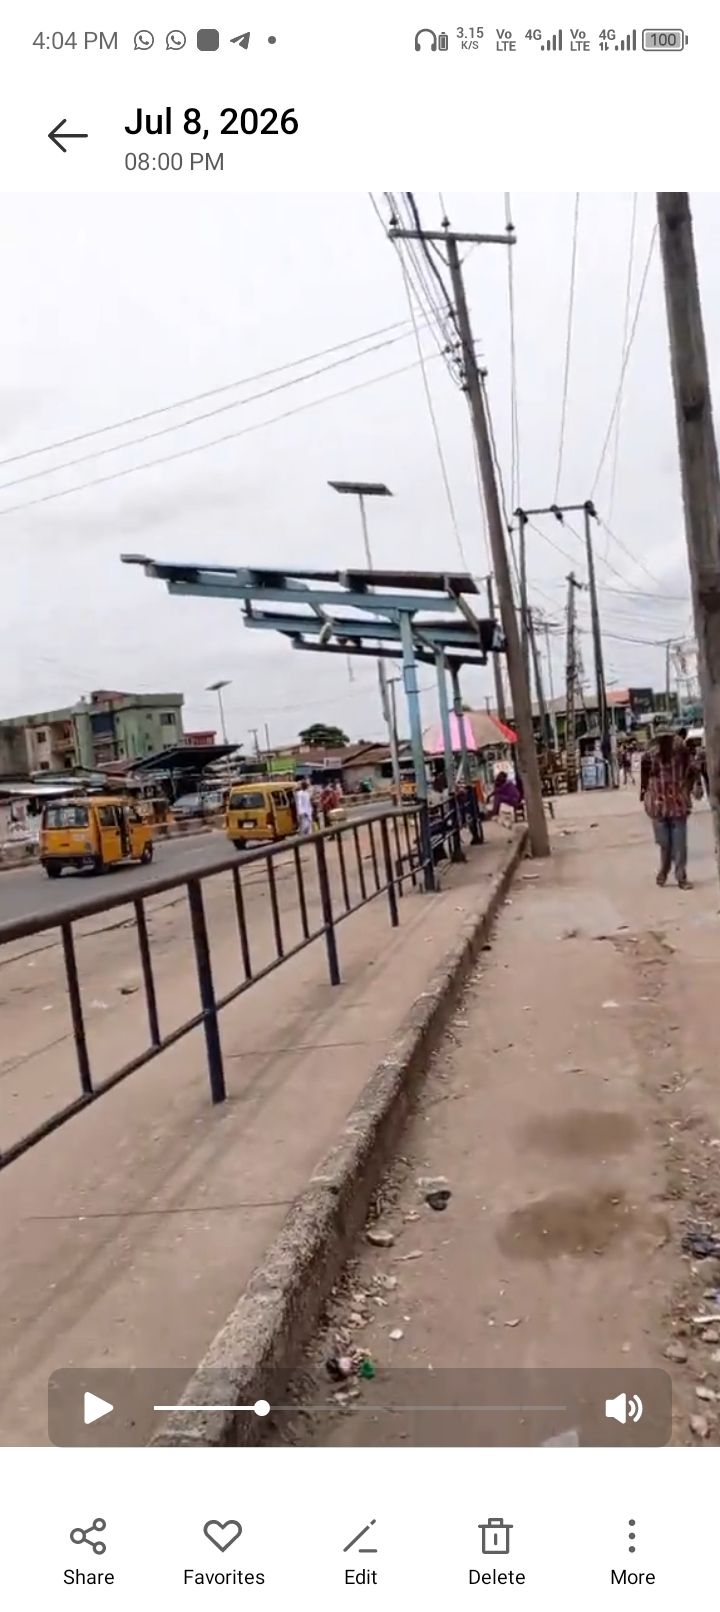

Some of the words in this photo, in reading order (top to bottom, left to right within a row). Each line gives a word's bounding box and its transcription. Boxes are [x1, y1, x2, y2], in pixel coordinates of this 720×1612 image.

[456, 26, 484, 39] 3.15
[495, 28, 513, 40] Vo
[524, 29, 542, 41] 4G
[569, 28, 587, 40] Vo
[598, 29, 616, 41] 4G
[32, 31, 78, 50] 4:04
[84, 31, 118, 50] PM
[461, 40, 479, 50] K/S
[650, 33, 676, 46] 100
[496, 41, 517, 52] LTE
[570, 41, 591, 52] LTE
[124, 106, 172, 136] Jul
[183, 107, 209, 141] 8,
[219, 107, 299, 135] 2026
[124, 152, 183, 171] 08:00
[190, 152, 224, 171] PM
[63, 1568, 115, 1585] Share
[183, 1568, 265, 1585] Favorites
[344, 1568, 378, 1585] Edit
[468, 1568, 526, 1585] Delete
[610, 1569, 656, 1585] More
